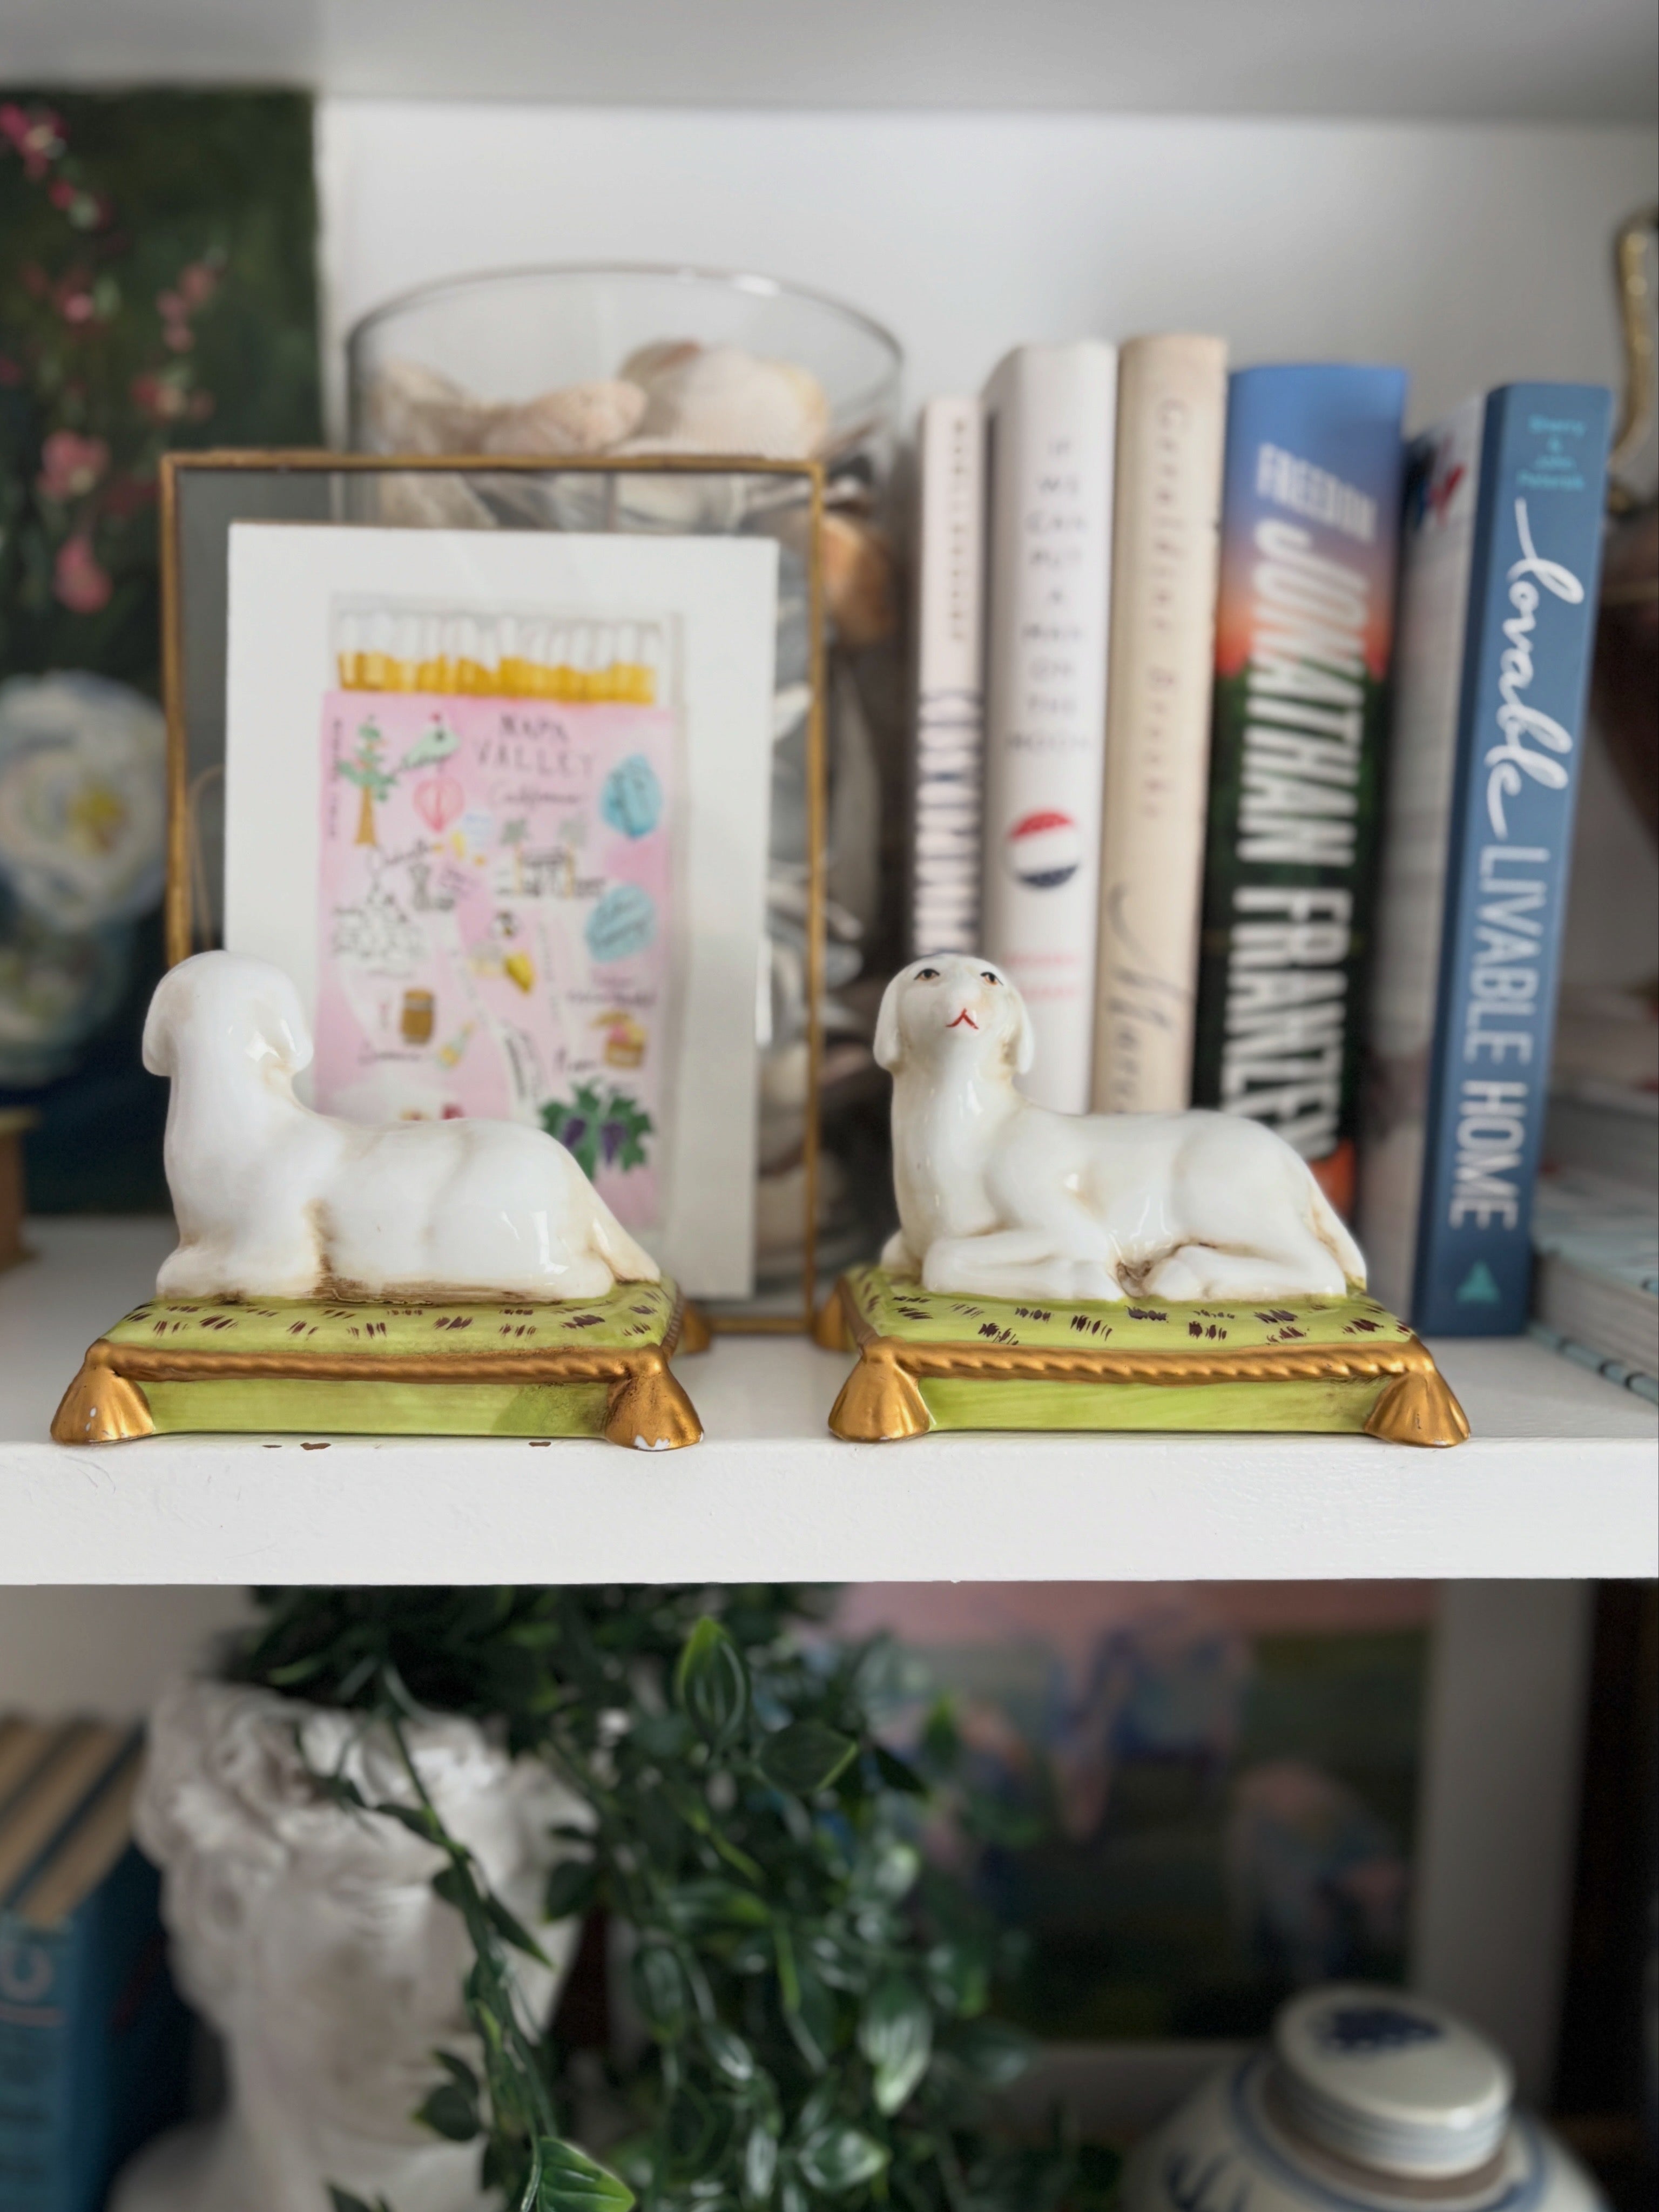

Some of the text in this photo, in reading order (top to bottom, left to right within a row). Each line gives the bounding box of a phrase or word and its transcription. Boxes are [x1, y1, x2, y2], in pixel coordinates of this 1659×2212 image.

[1257, 442, 1377, 545] FREEDOM
[1240, 517, 1368, 864] JONATHAN
[1448, 497, 1586, 1231] lovable LIVABLE HOME
